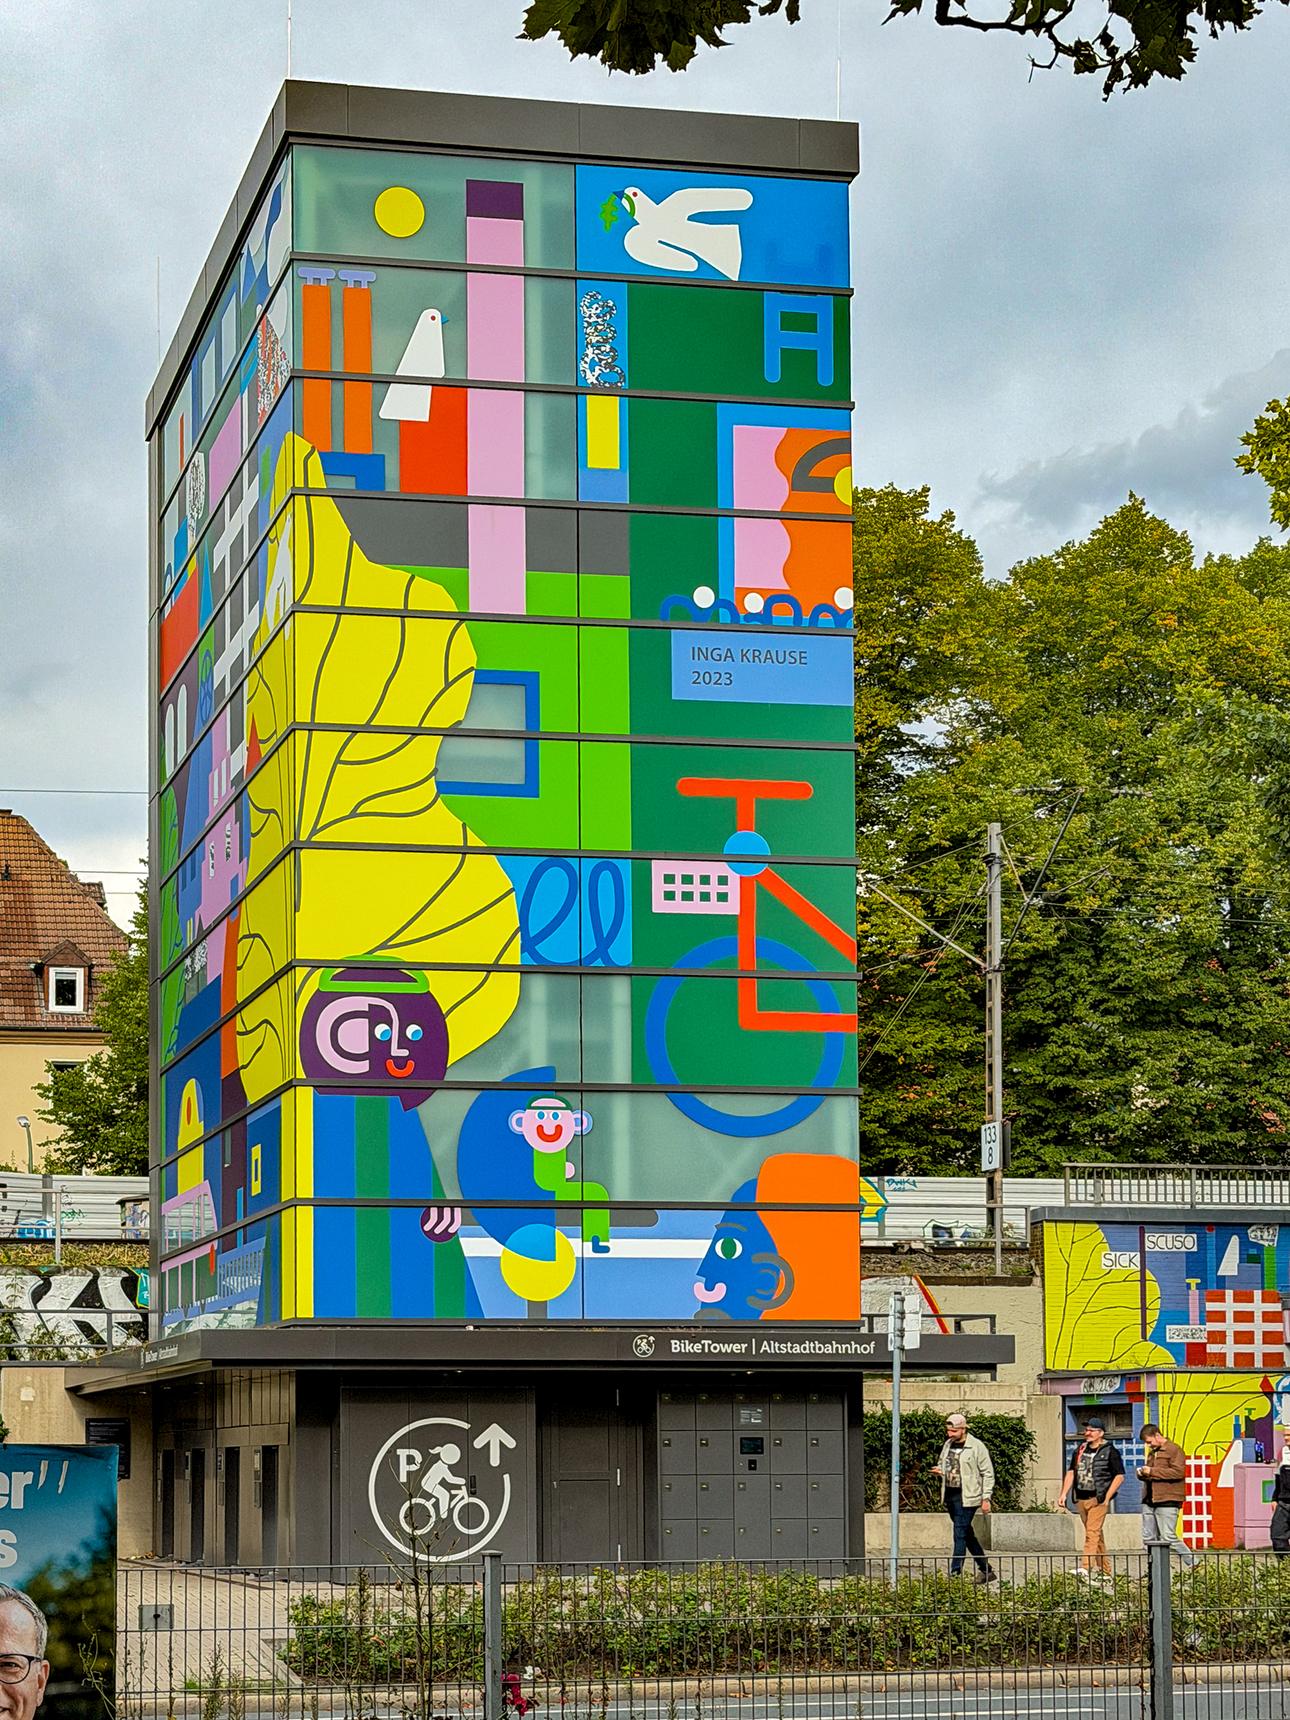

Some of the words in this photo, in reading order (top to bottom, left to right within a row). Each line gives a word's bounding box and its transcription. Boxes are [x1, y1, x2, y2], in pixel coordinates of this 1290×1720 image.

[691, 646, 735, 663] INGA
[740, 648, 808, 665] KRAUSE
[691, 670, 733, 686] 2023
[983, 1125, 997, 1145] 133
[987, 1146, 994, 1165] 8
[1146, 1234, 1195, 1250] SCUSO
[1102, 1252, 1139, 1268] SICK
[670, 1339, 748, 1354] BikeTower
[760, 1340, 876, 1355] Altstadtbahnhof
[396, 1448, 423, 1483] P
